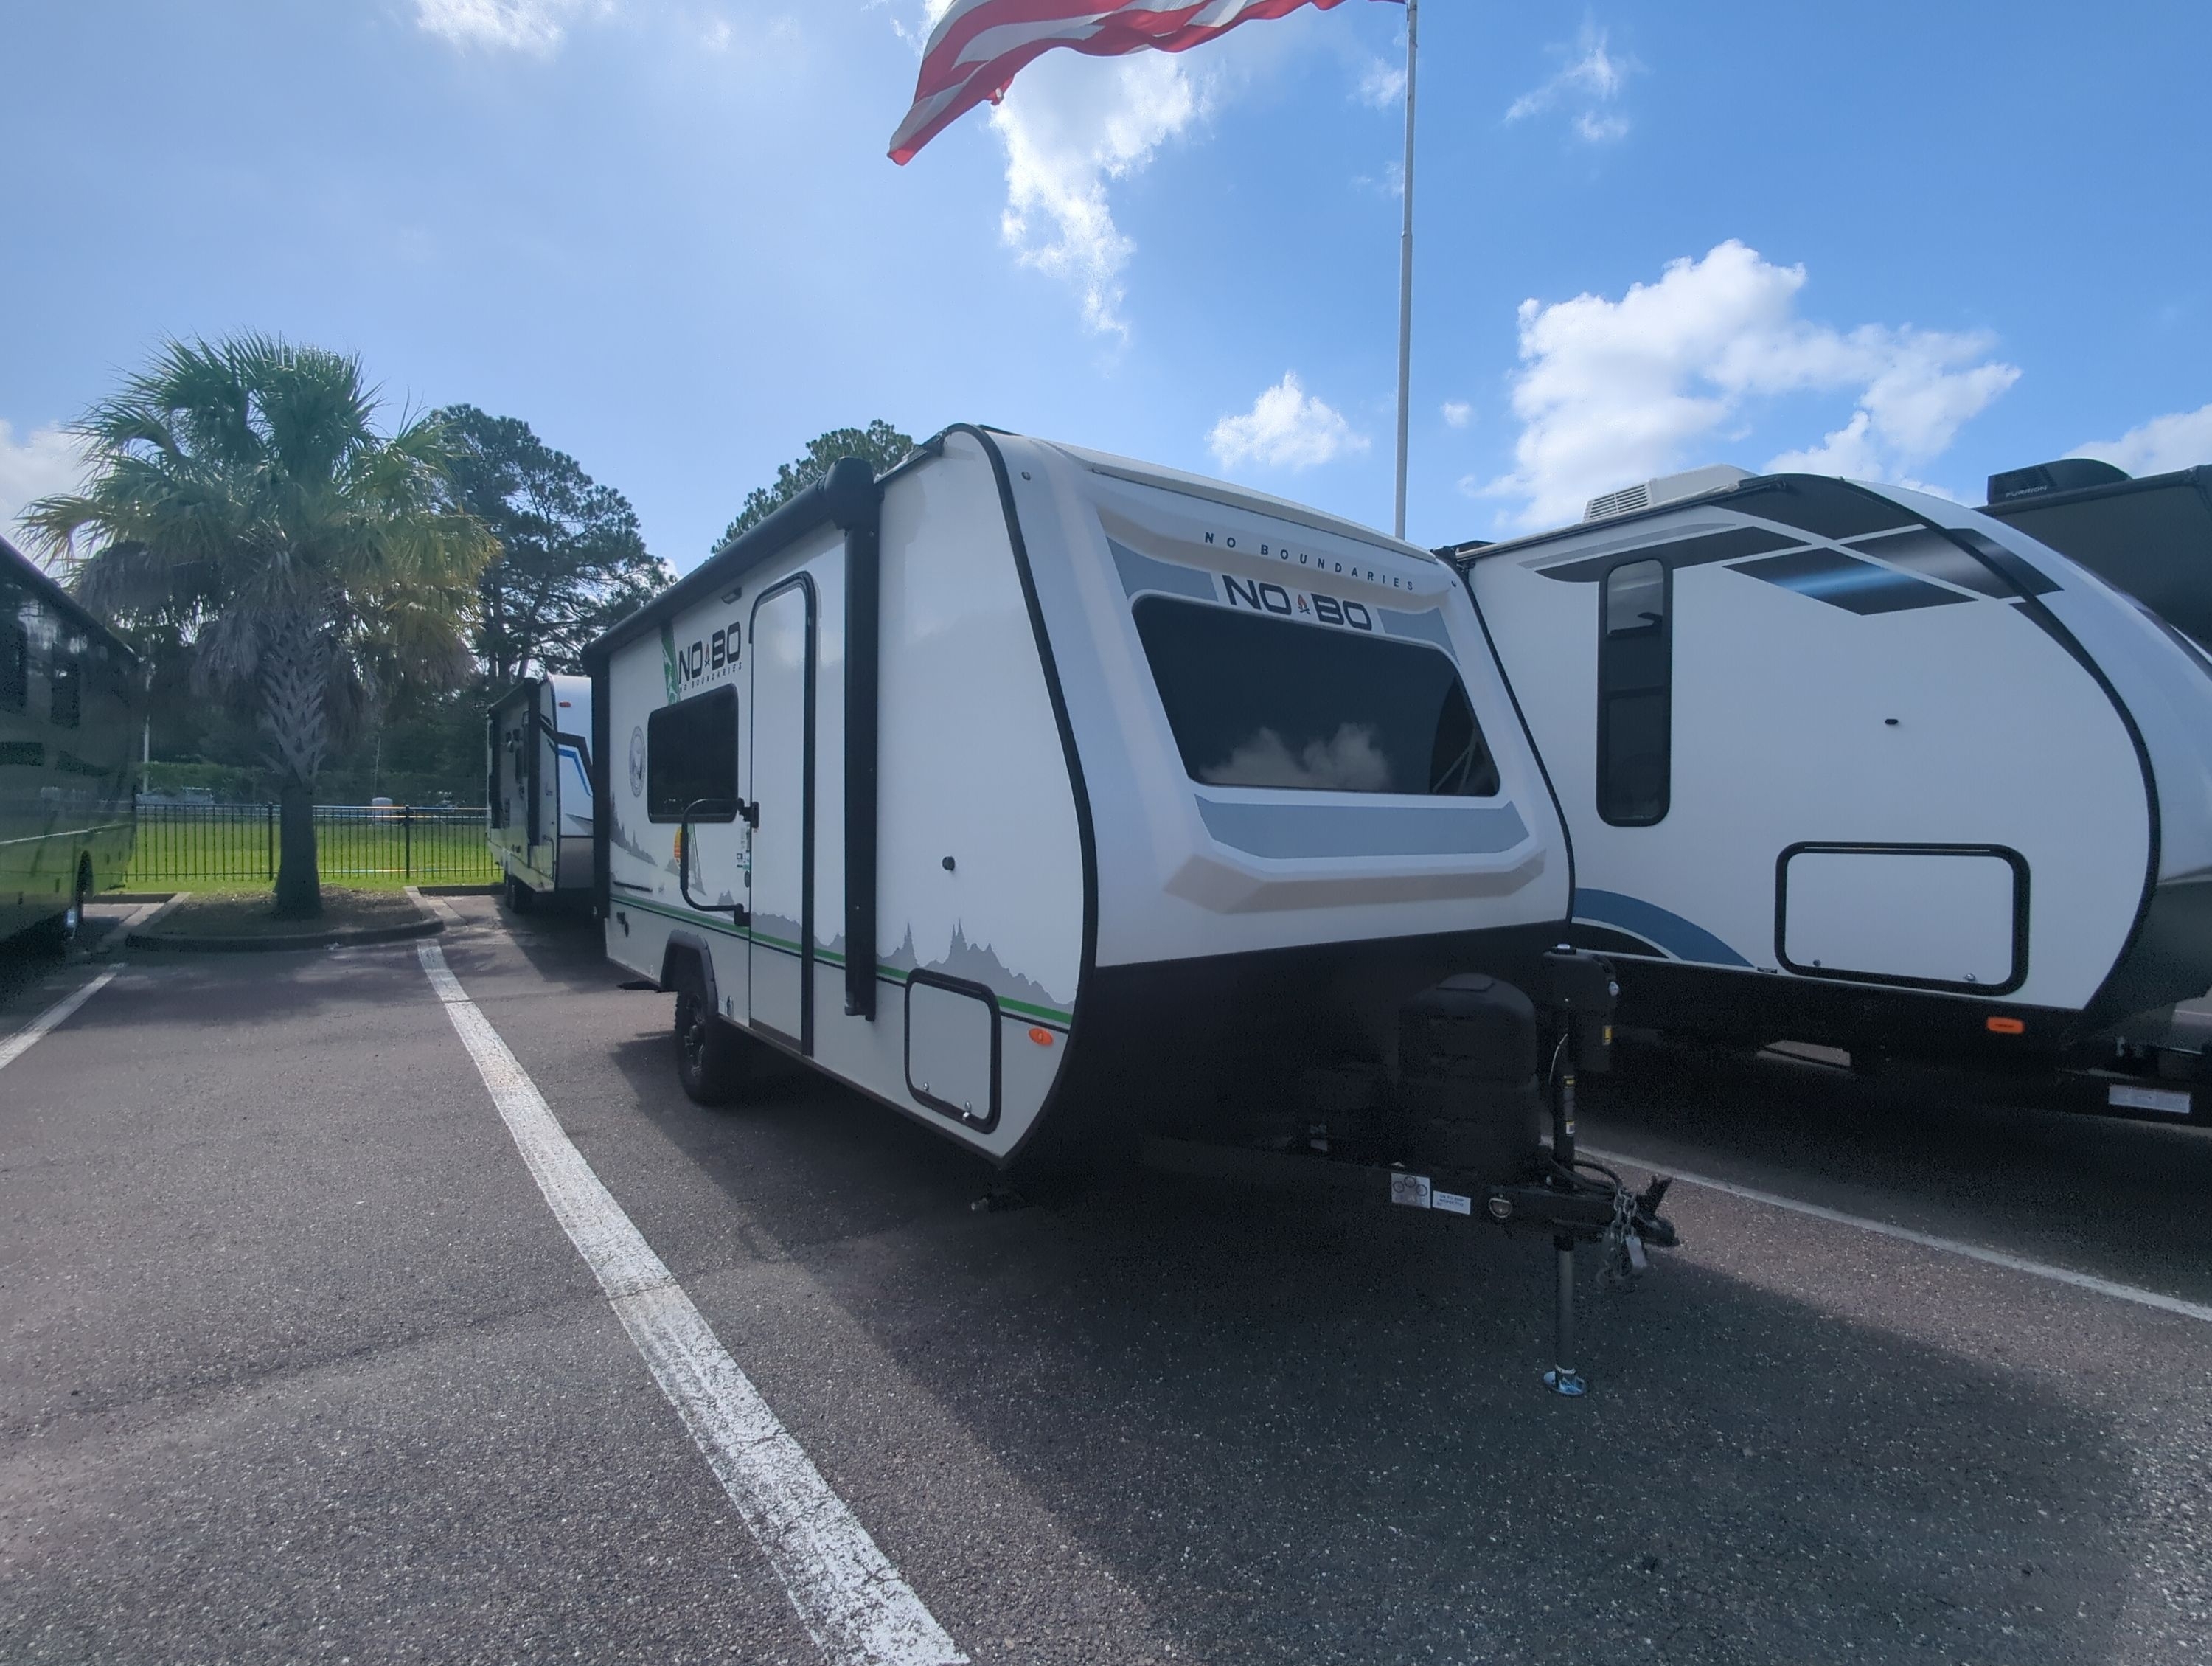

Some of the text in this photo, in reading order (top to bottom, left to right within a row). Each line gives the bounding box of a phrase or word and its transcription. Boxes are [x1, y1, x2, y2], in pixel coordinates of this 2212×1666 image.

[1205, 532, 1414, 591] NO BOUNDARIES
[691, 662, 742, 689] BOUNDARIES
